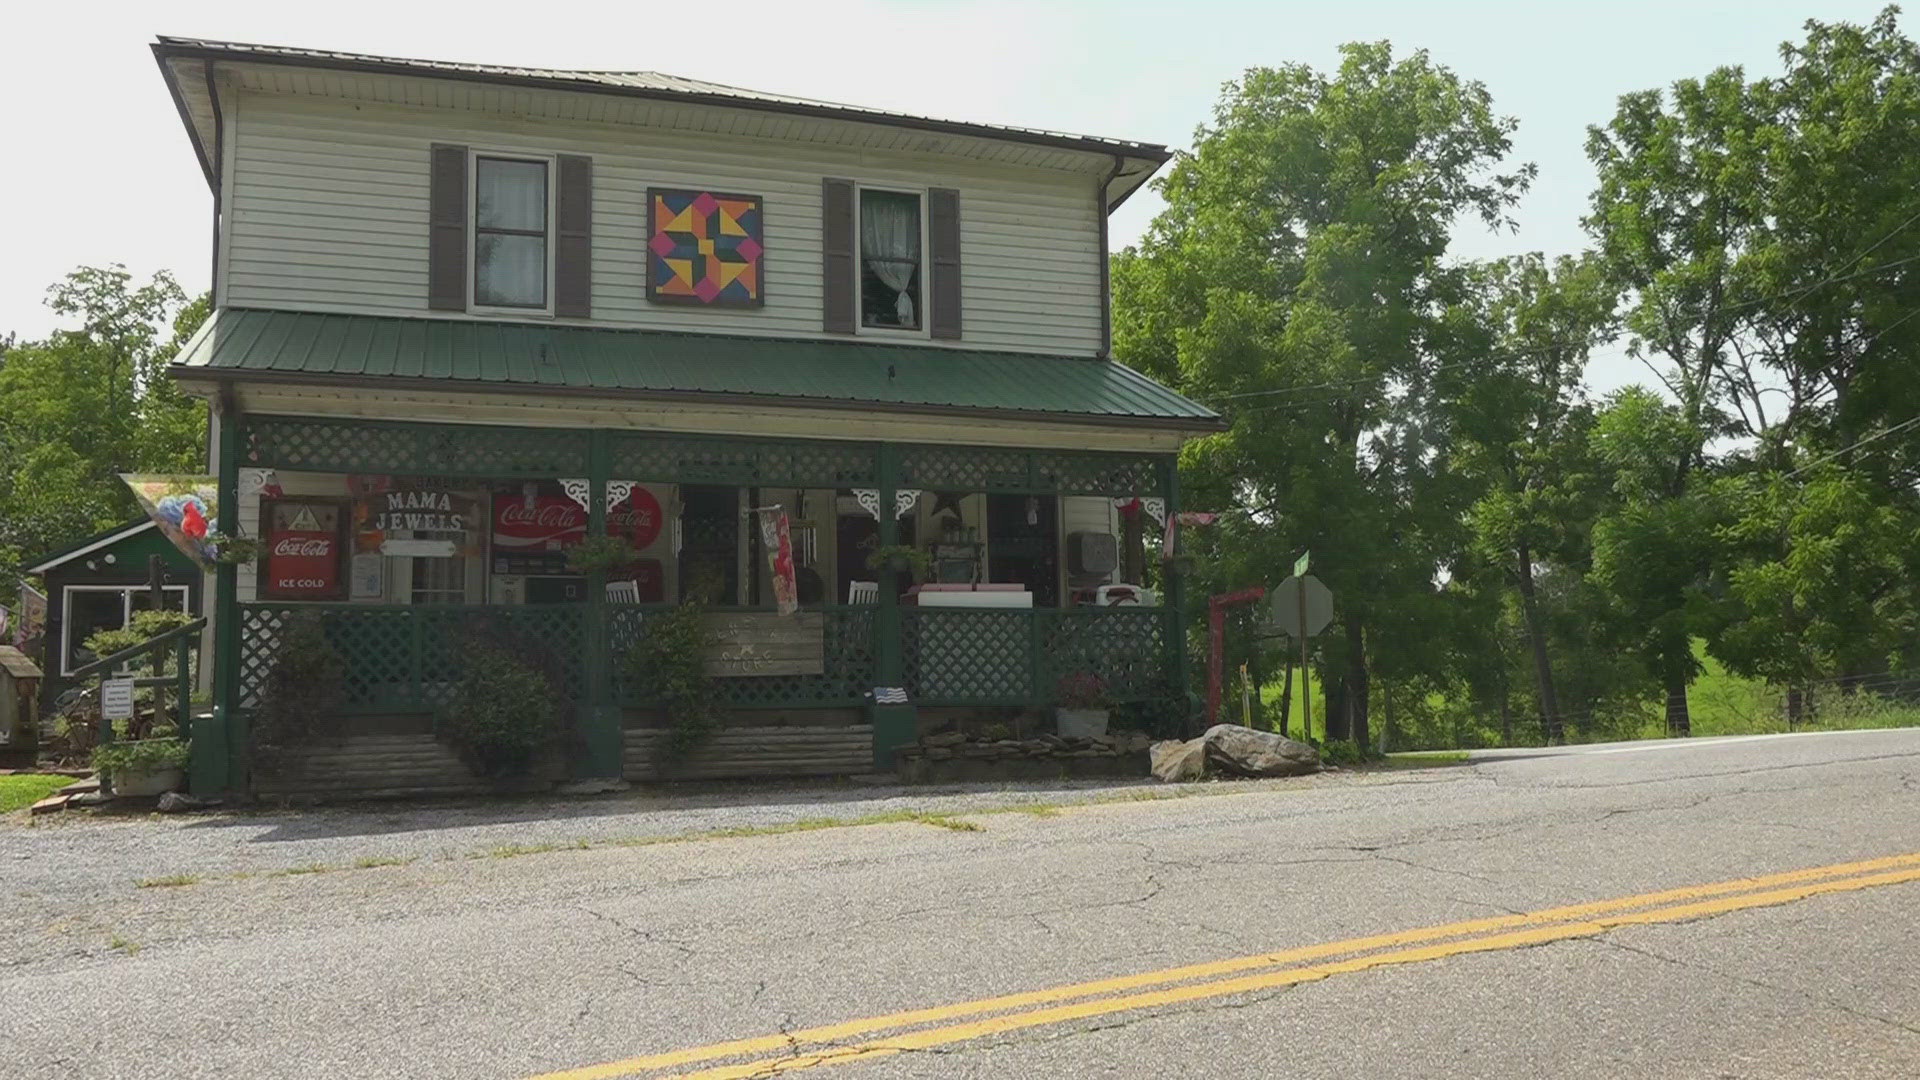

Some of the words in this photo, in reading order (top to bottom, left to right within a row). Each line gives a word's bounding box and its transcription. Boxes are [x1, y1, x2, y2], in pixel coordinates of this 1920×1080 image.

[387, 491, 451, 511] MAMA
[376, 513, 464, 531] JEWELS
[500, 504, 579, 527] Coca-Cola
[606, 509, 652, 527] oca-Cola
[274, 538, 330, 556] Coca-Cola
[279, 579, 295, 588] ICE
[297, 579, 325, 588] COLD
